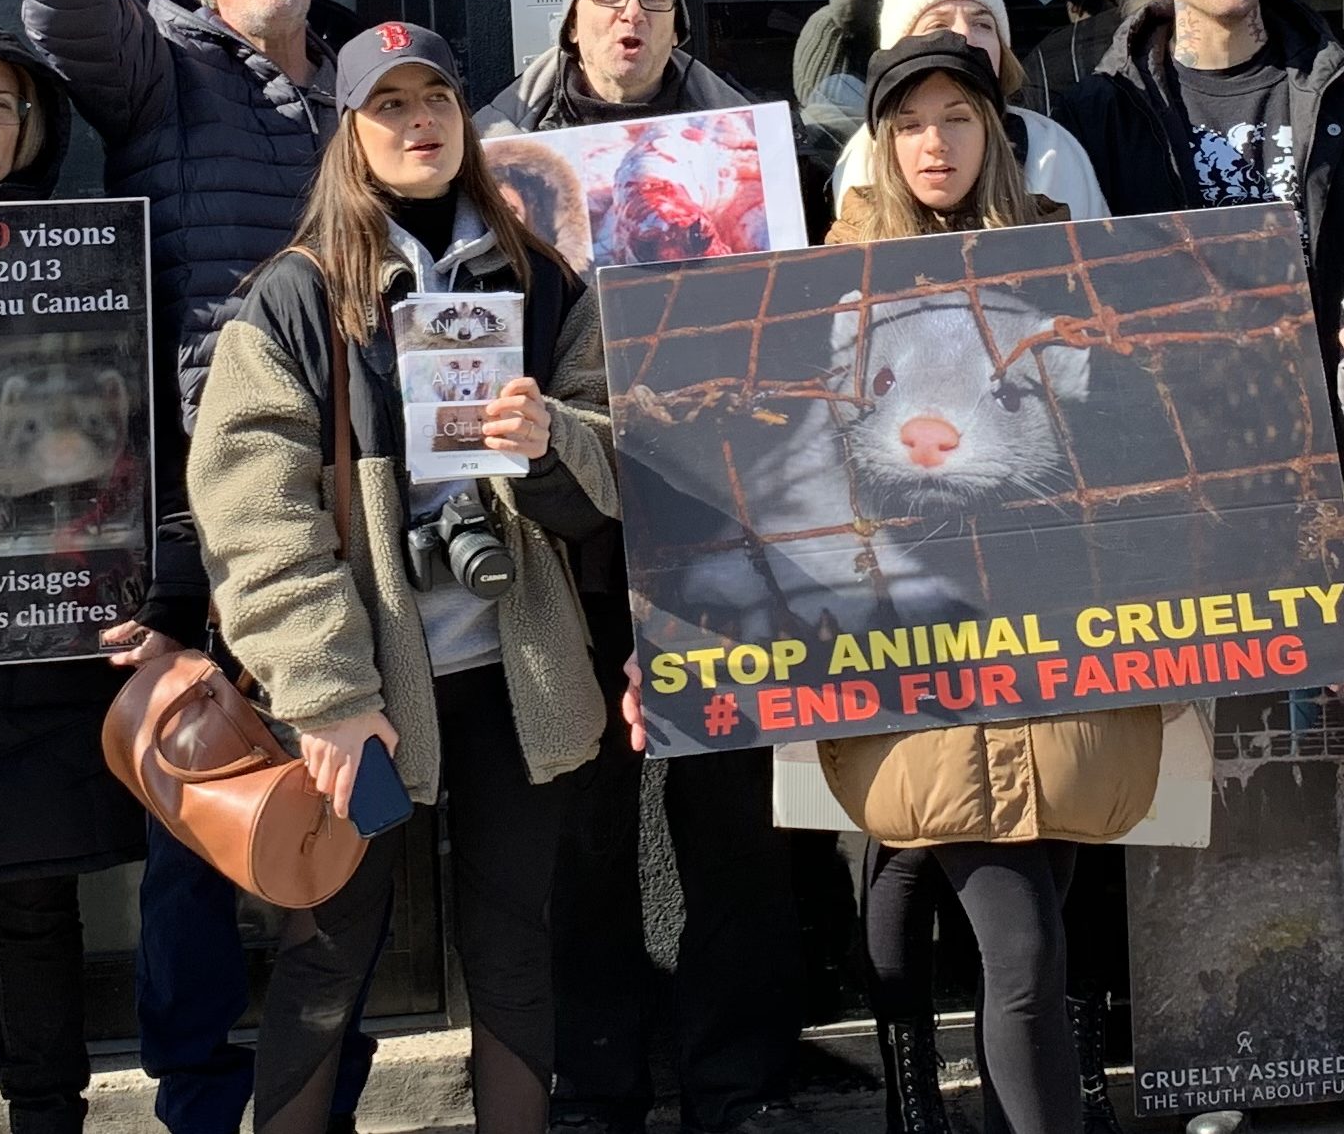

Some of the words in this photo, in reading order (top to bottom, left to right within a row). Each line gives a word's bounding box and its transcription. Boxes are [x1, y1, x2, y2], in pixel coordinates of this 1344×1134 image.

[376, 23, 413, 52] B
[19, 223, 116, 248] visons
[32, 289, 129, 314] Canada
[15, 601, 117, 627] chiffres
[650, 641, 806, 695] STOP
[828, 614, 1059, 676] ANIMAL
[704, 694, 738, 737] #
[756, 677, 881, 731] END
[901, 666, 1022, 715] FUR
[1041, 634, 1307, 701] FARMING
[1141, 1065, 1239, 1090] CRUELTY
[1142, 1095, 1179, 1110] THE
[1184, 1087, 1246, 1108] TRUTH
[1252, 1080, 1316, 1101] ABOUT
